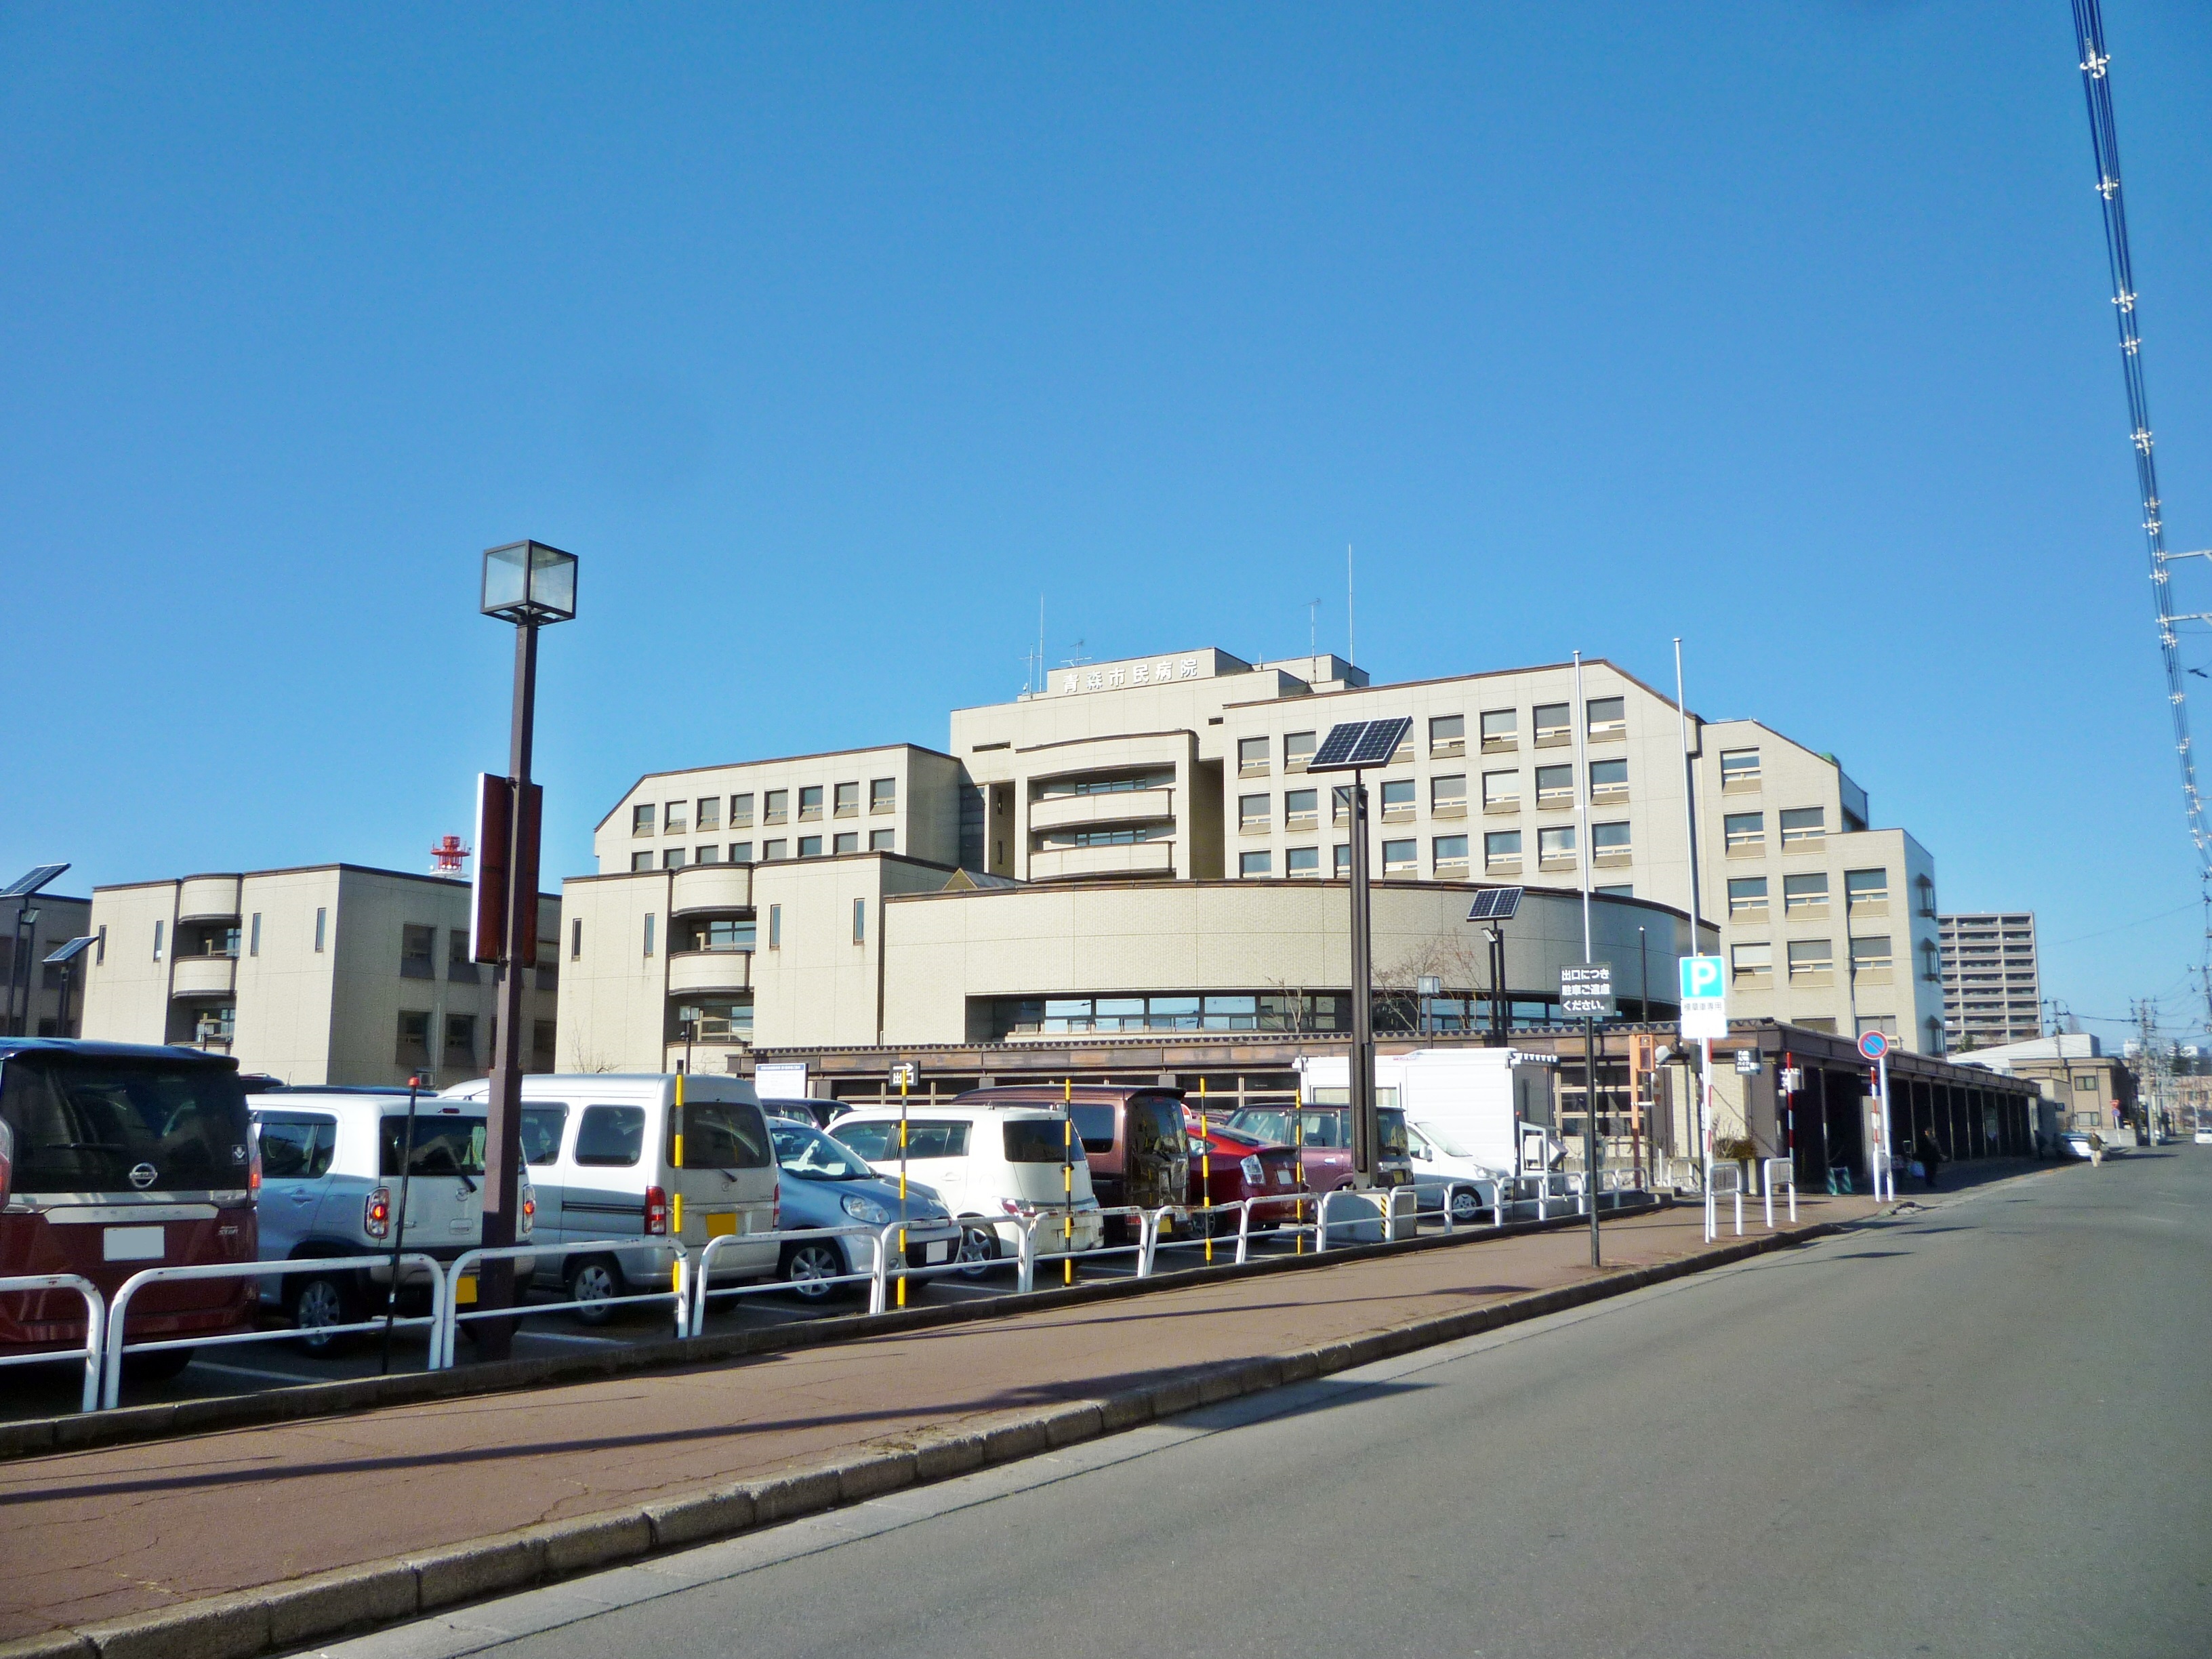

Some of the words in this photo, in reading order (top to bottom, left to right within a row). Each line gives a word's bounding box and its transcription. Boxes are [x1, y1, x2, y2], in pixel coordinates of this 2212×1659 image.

[1063, 658, 1197, 693] 青森市民病院
[1561, 968, 1610, 981] 出口につき
[1692, 960, 1717, 996] P
[1563, 1000, 1605, 1011] ください。
[893, 1072, 914, 1084] 出口
